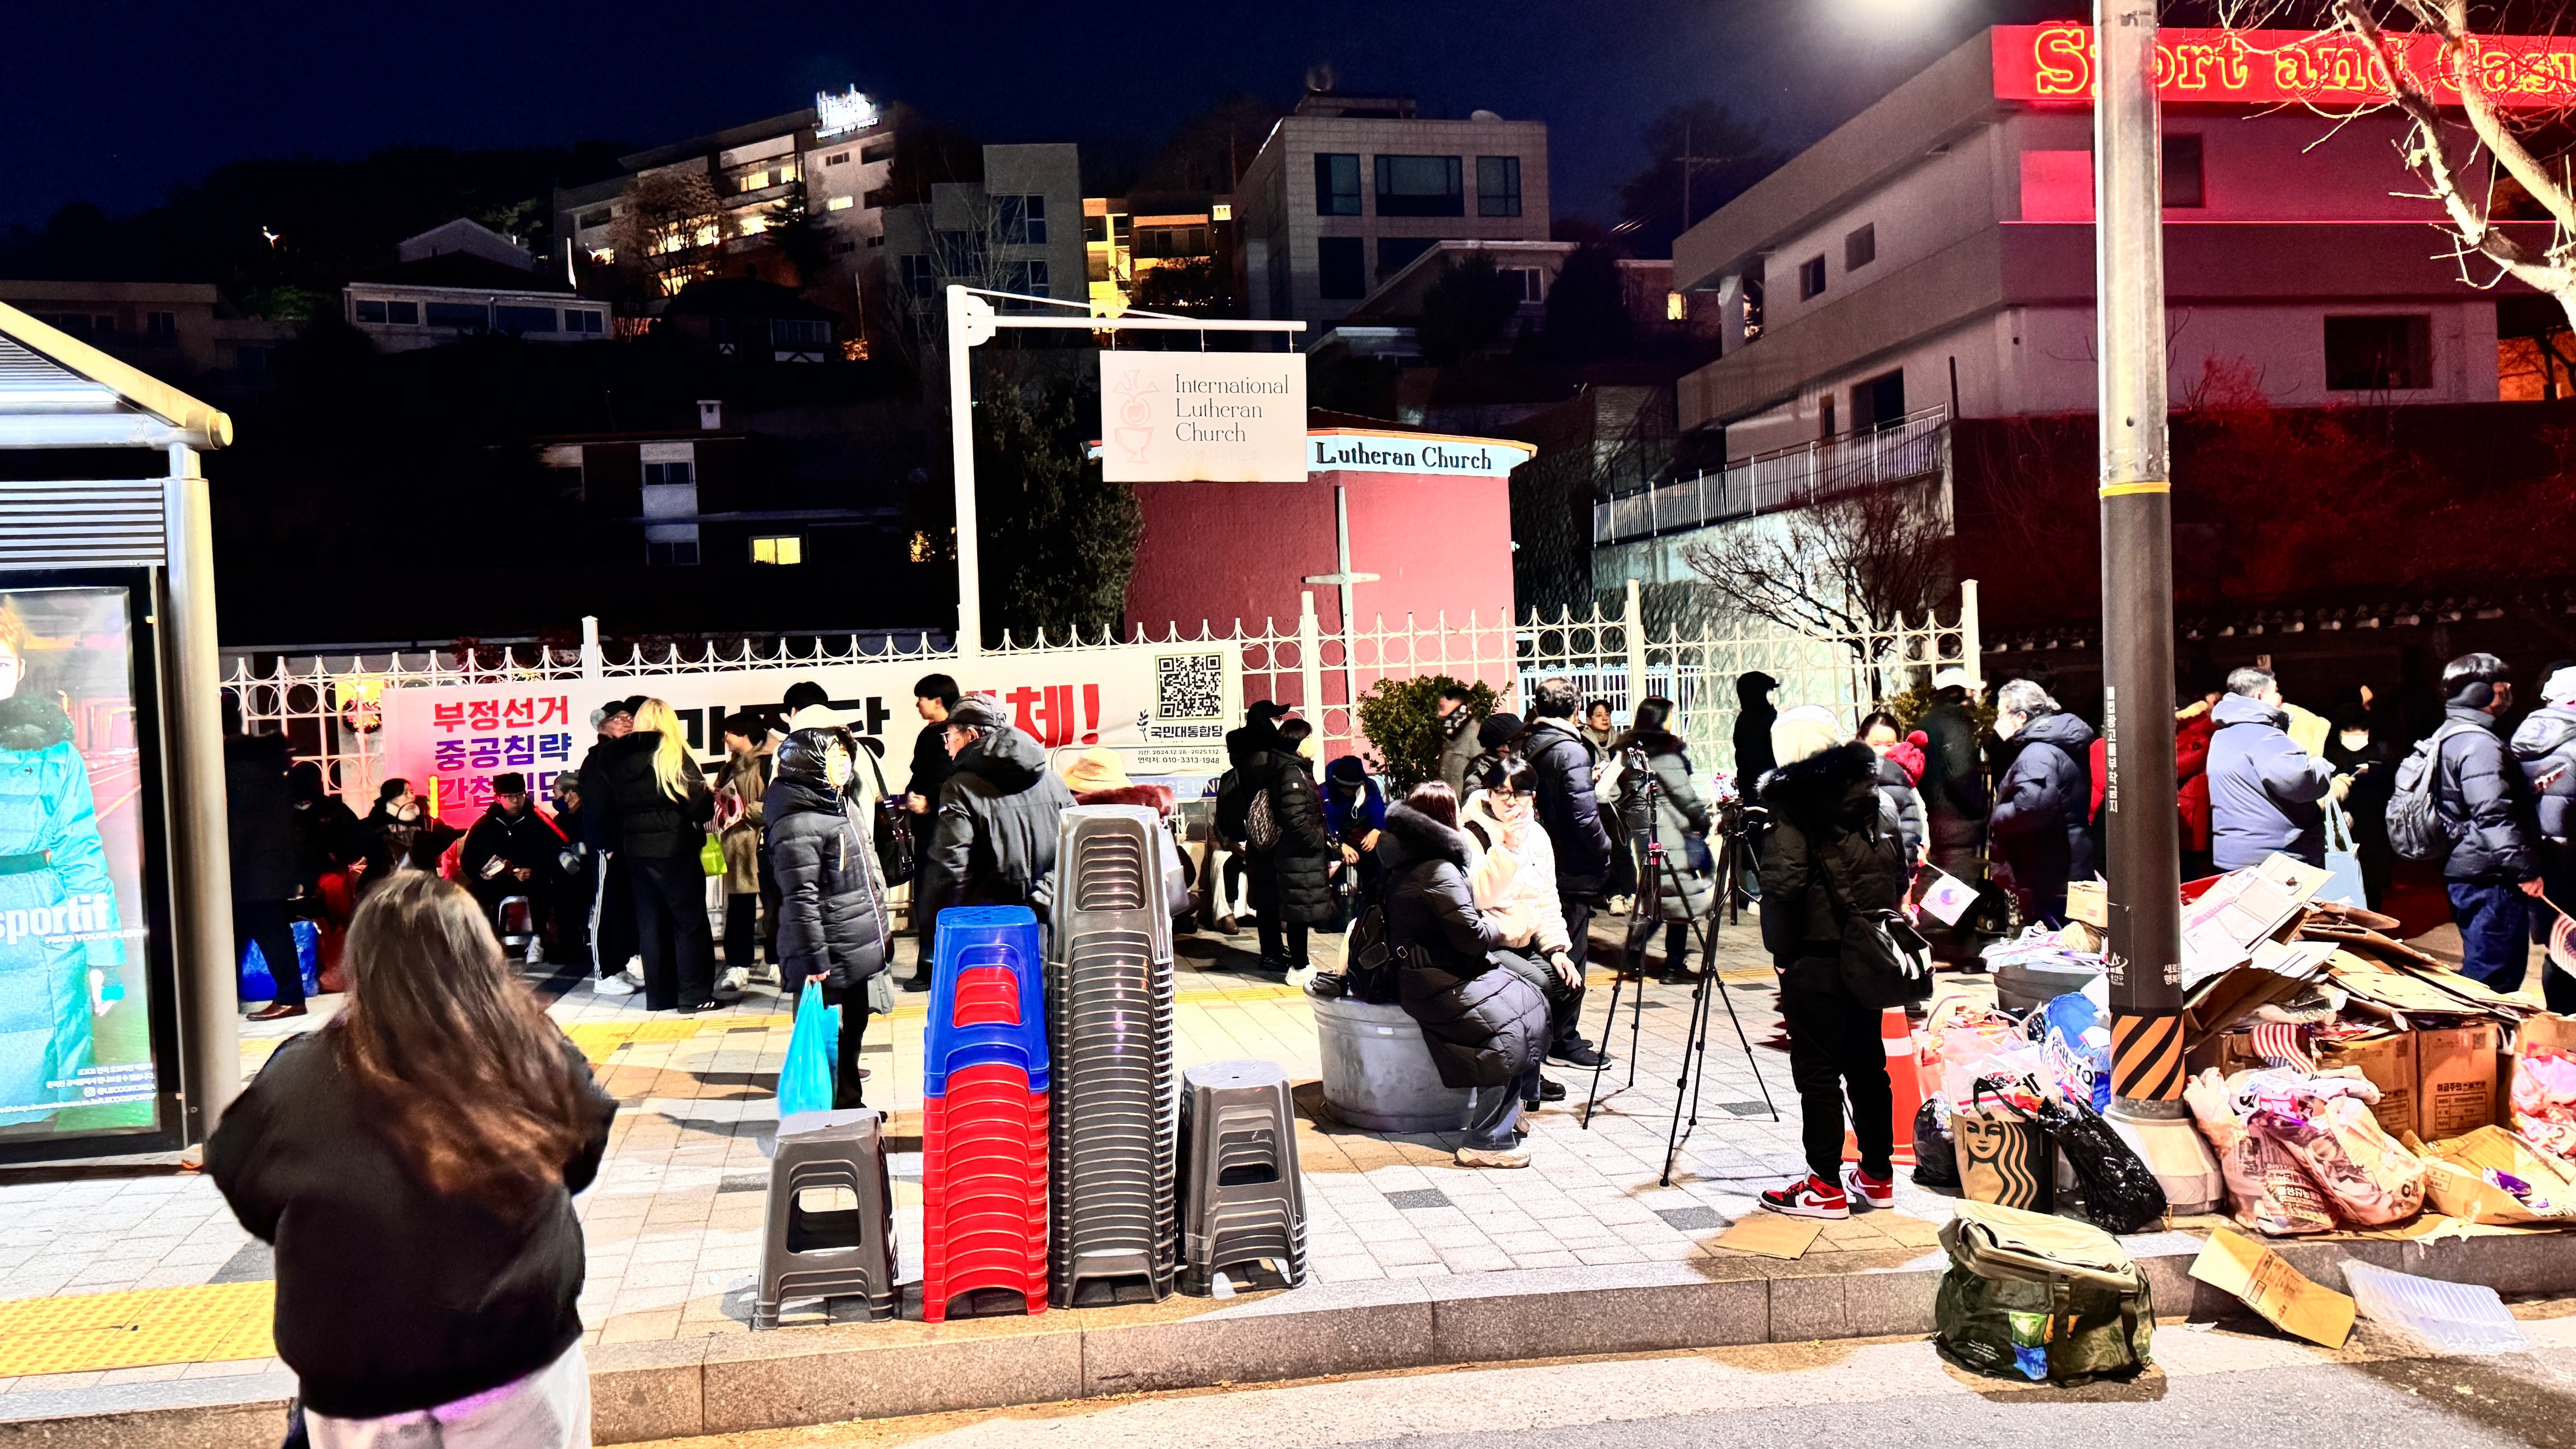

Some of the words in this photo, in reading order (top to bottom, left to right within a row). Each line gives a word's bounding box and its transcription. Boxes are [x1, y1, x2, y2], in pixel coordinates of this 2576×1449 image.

[2035, 29, 2248, 93] Sort
[1175, 373, 1288, 394] International
[1176, 398, 1262, 418] Lutheran
[1176, 422, 1246, 442] Church
[1315, 441, 1416, 466] Lutheran
[1421, 446, 1492, 469] Church
[433, 695, 569, 733] 부정선거
[964, 683, 1099, 749] 체!
[1150, 725, 1224, 739] 국민대통합당
[434, 732, 572, 772] 중공침략
[1191, 779, 1221, 795] LIN
[74, 930, 109, 942] YOUR
